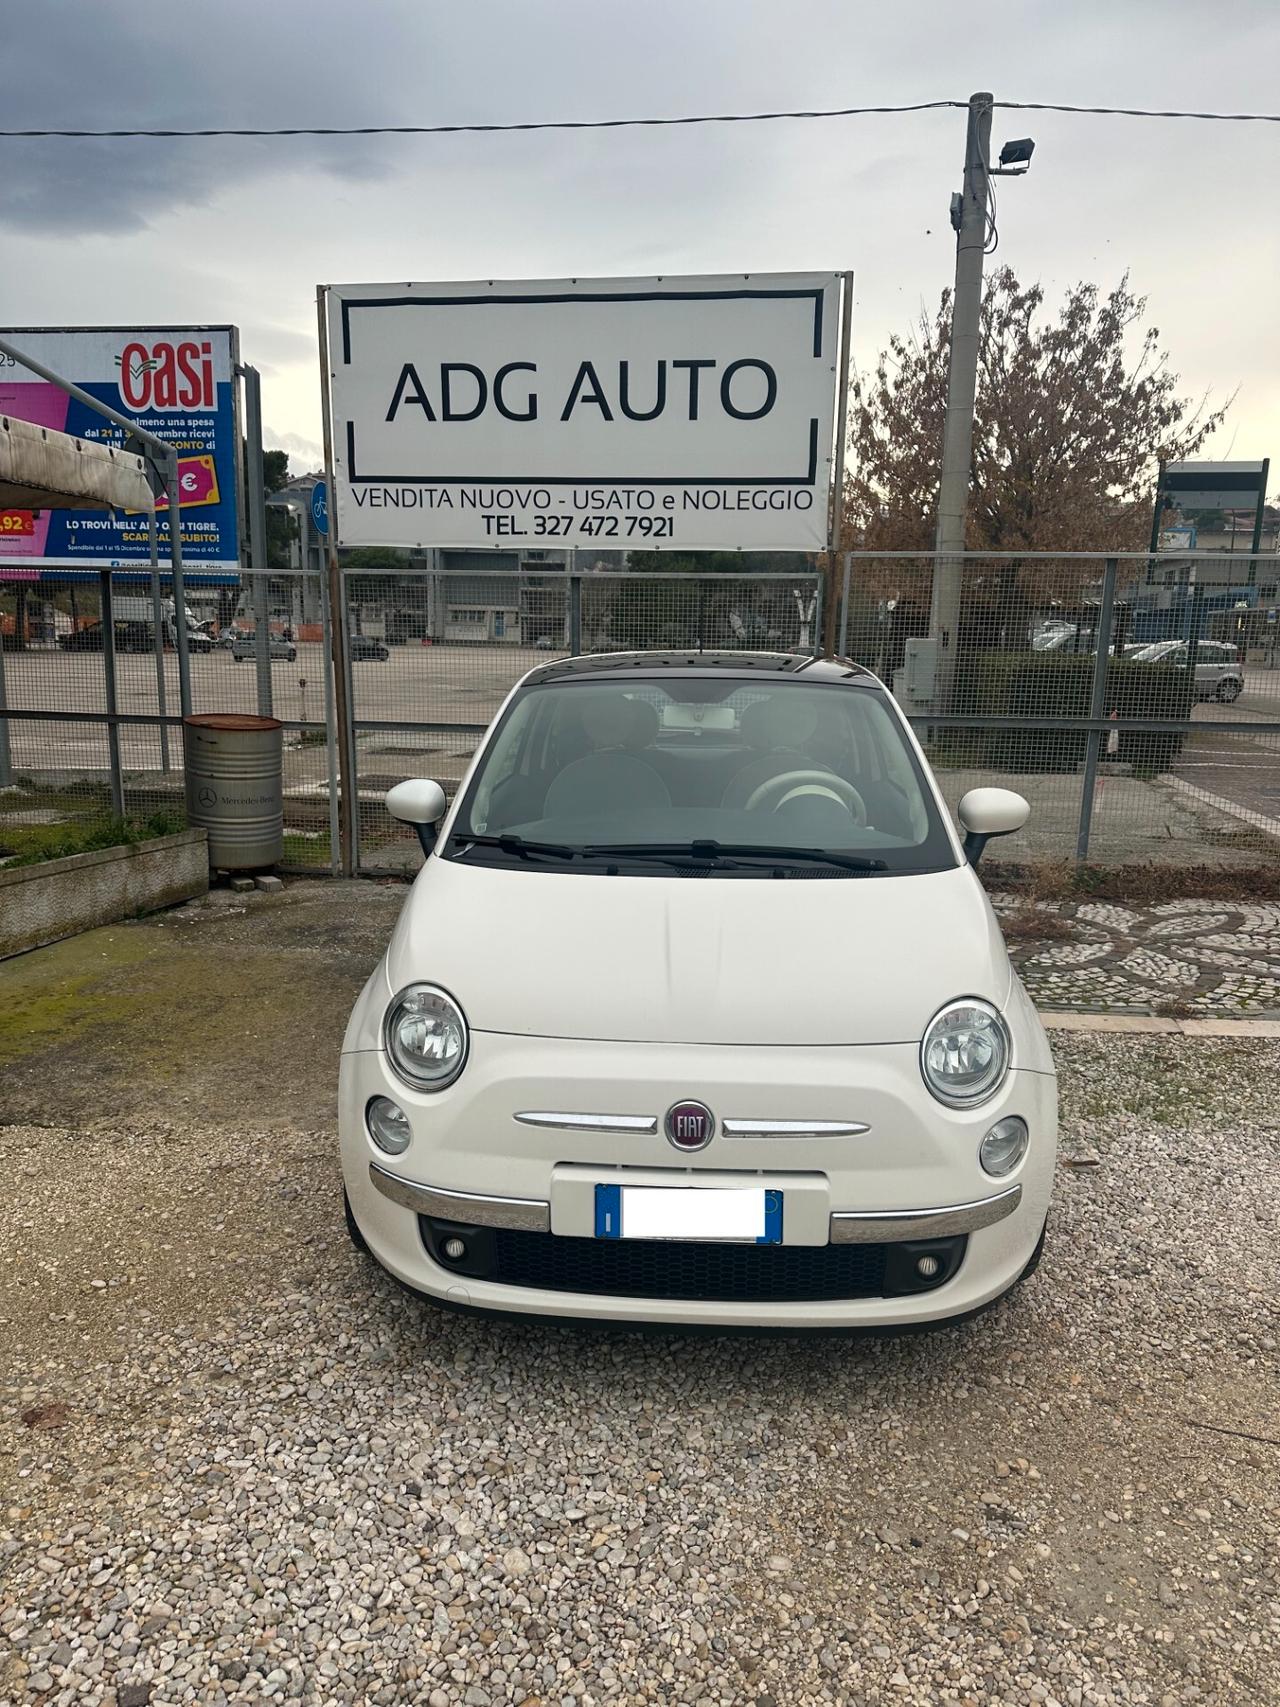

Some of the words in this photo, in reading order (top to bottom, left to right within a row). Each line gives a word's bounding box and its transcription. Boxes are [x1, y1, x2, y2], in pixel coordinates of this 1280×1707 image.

[385, 361, 538, 422] ADG
[560, 358, 778, 421] AUTO
[187, 419, 214, 428] spesa
[85, 429, 99, 438] dal
[189, 429, 215, 438] ricevi
[206, 441, 216, 449] di
[350, 488, 454, 510] VENDITA
[460, 489, 552, 510] NUOVO
[573, 489, 656, 511] USATO
[662, 495, 675, 511] e
[682, 490, 814, 512] NOLEGGIO
[66, 520, 80, 529] LO
[81, 521, 111, 529] TROVI
[187, 522, 219, 531] TIGRE.
[481, 515, 528, 536] TEL.
[534, 516, 574, 537] 327
[579, 516, 619, 537] 472
[625, 516, 675, 538] 7921
[180, 533, 220, 542] SUBITO!
[677, 1116, 704, 1137] FIAT
